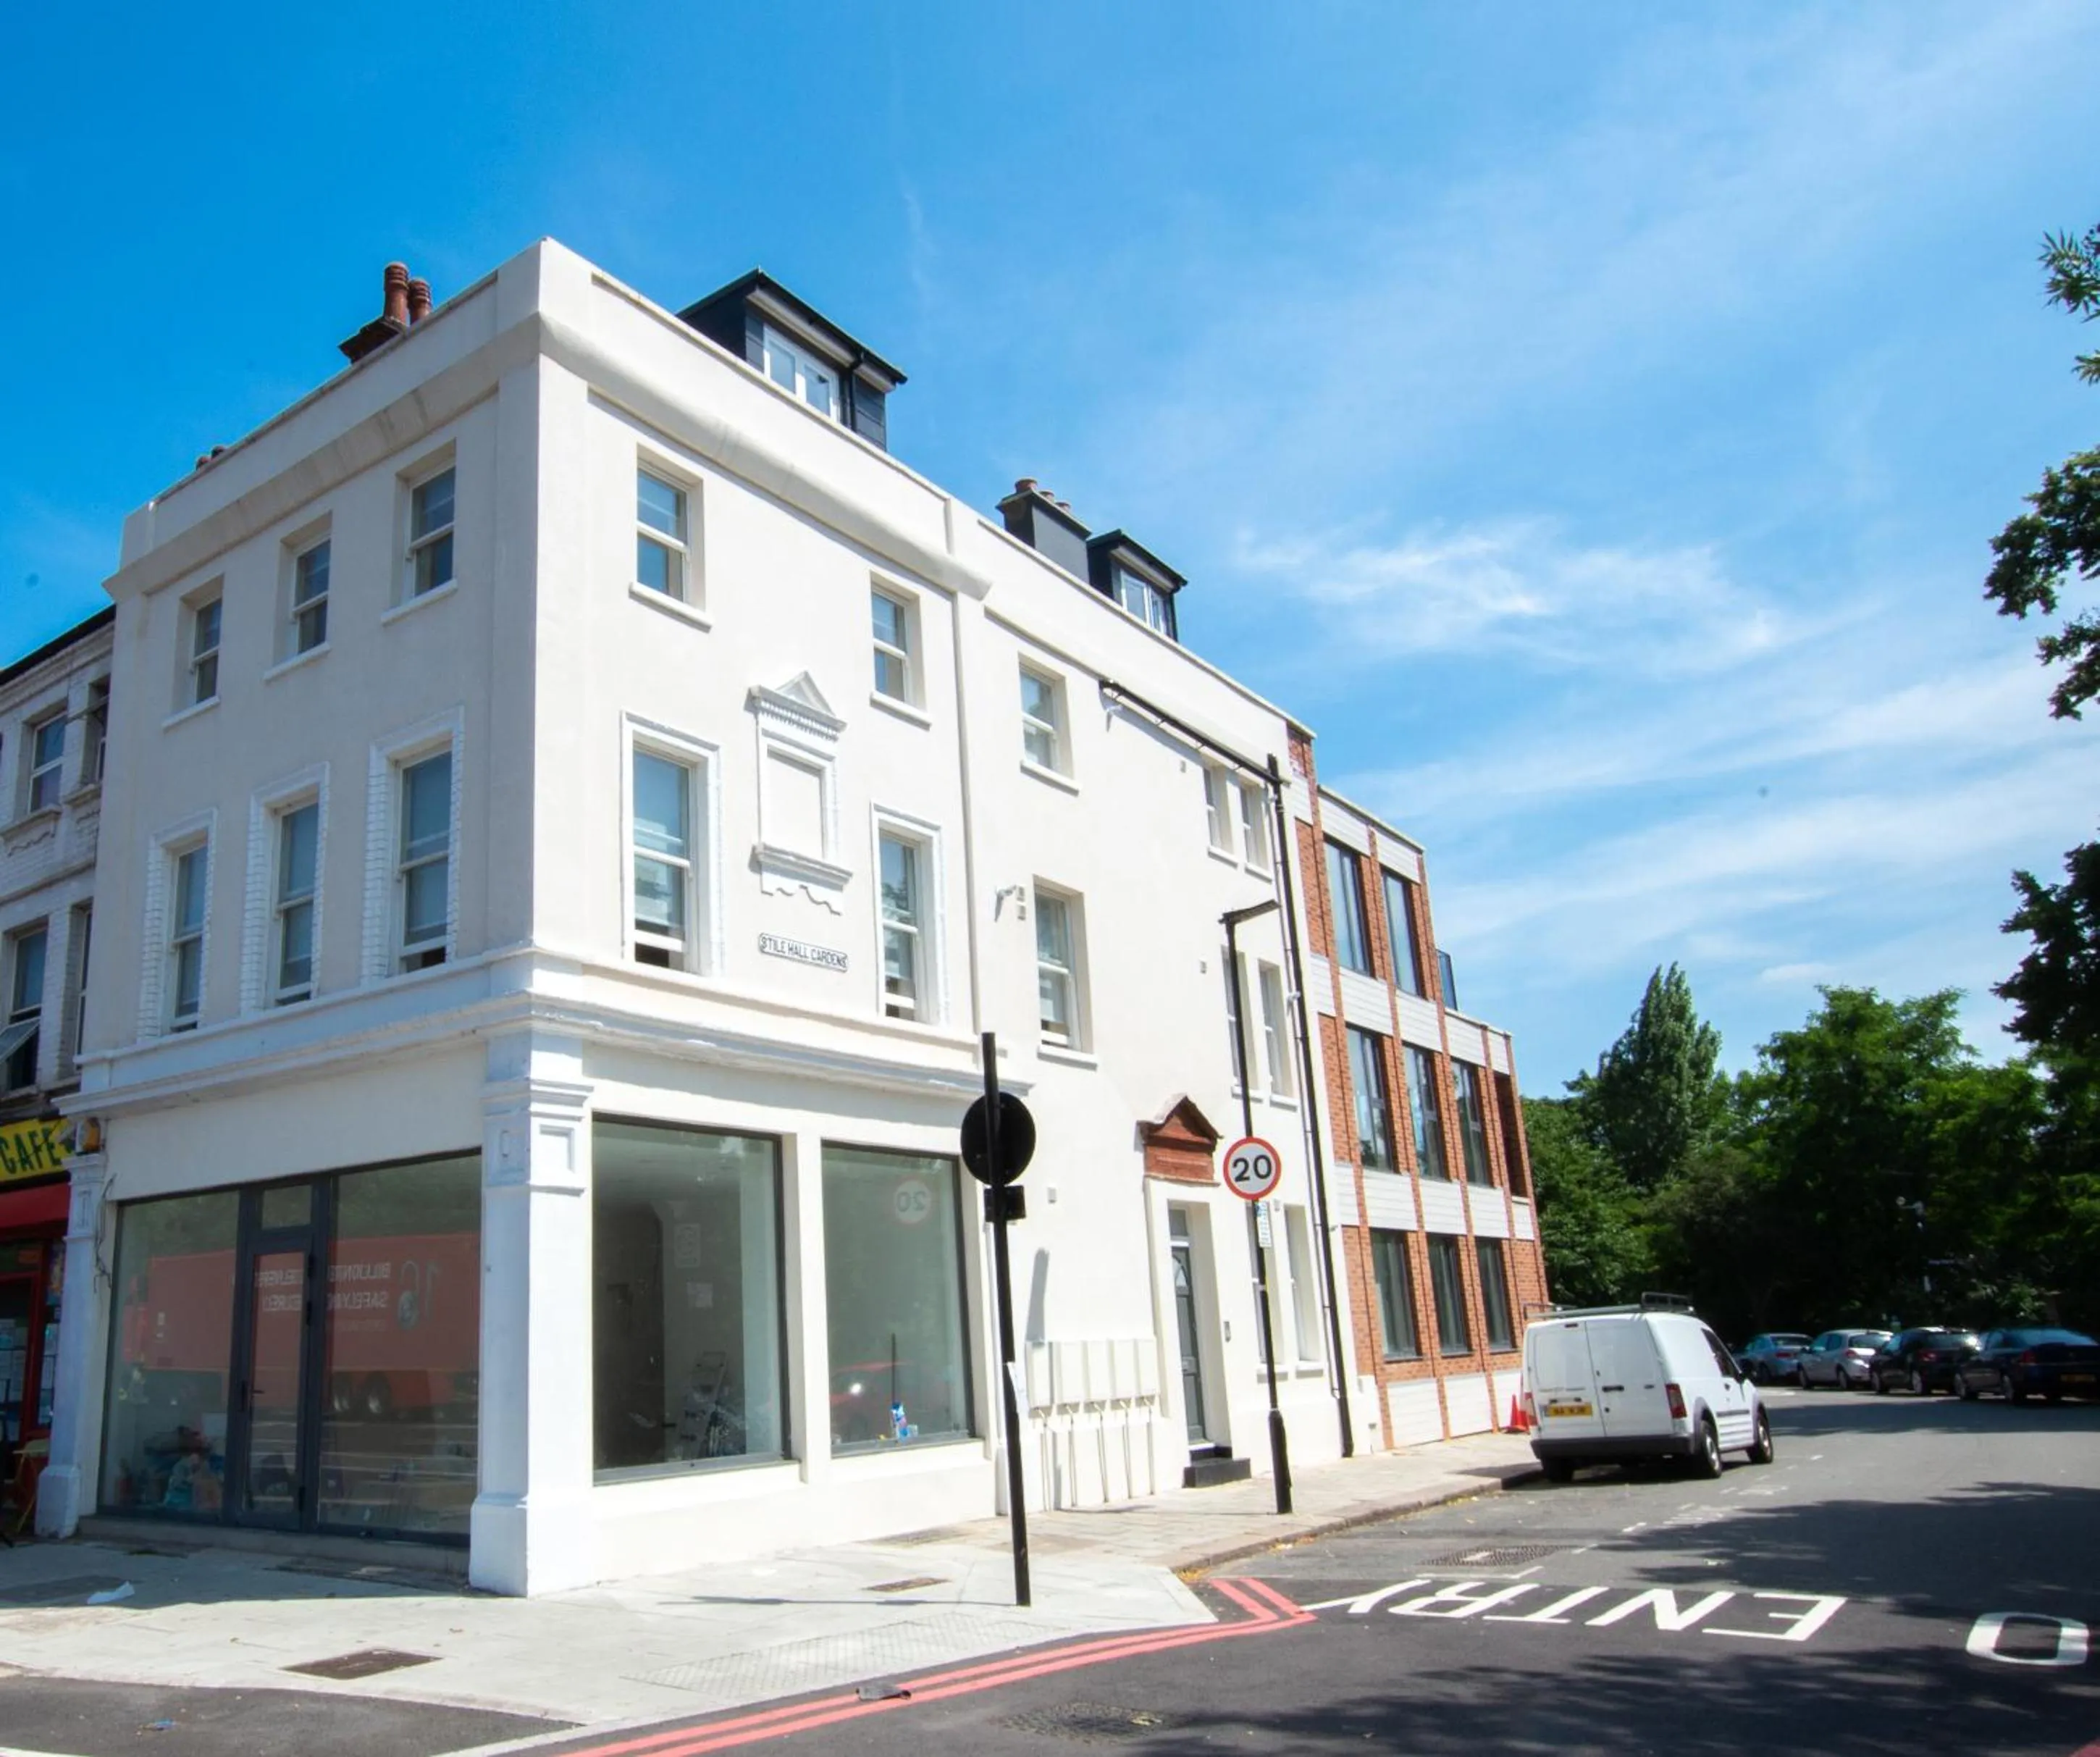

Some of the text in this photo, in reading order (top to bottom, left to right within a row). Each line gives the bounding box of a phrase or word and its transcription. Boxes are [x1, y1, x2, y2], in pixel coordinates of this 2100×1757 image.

[761, 936, 847, 968] STILE HALL GARDENS
[0, 1125, 63, 1175] CAFE
[1232, 1154, 1272, 1182] 20
[1300, 1578, 1847, 1642] ENTRY
